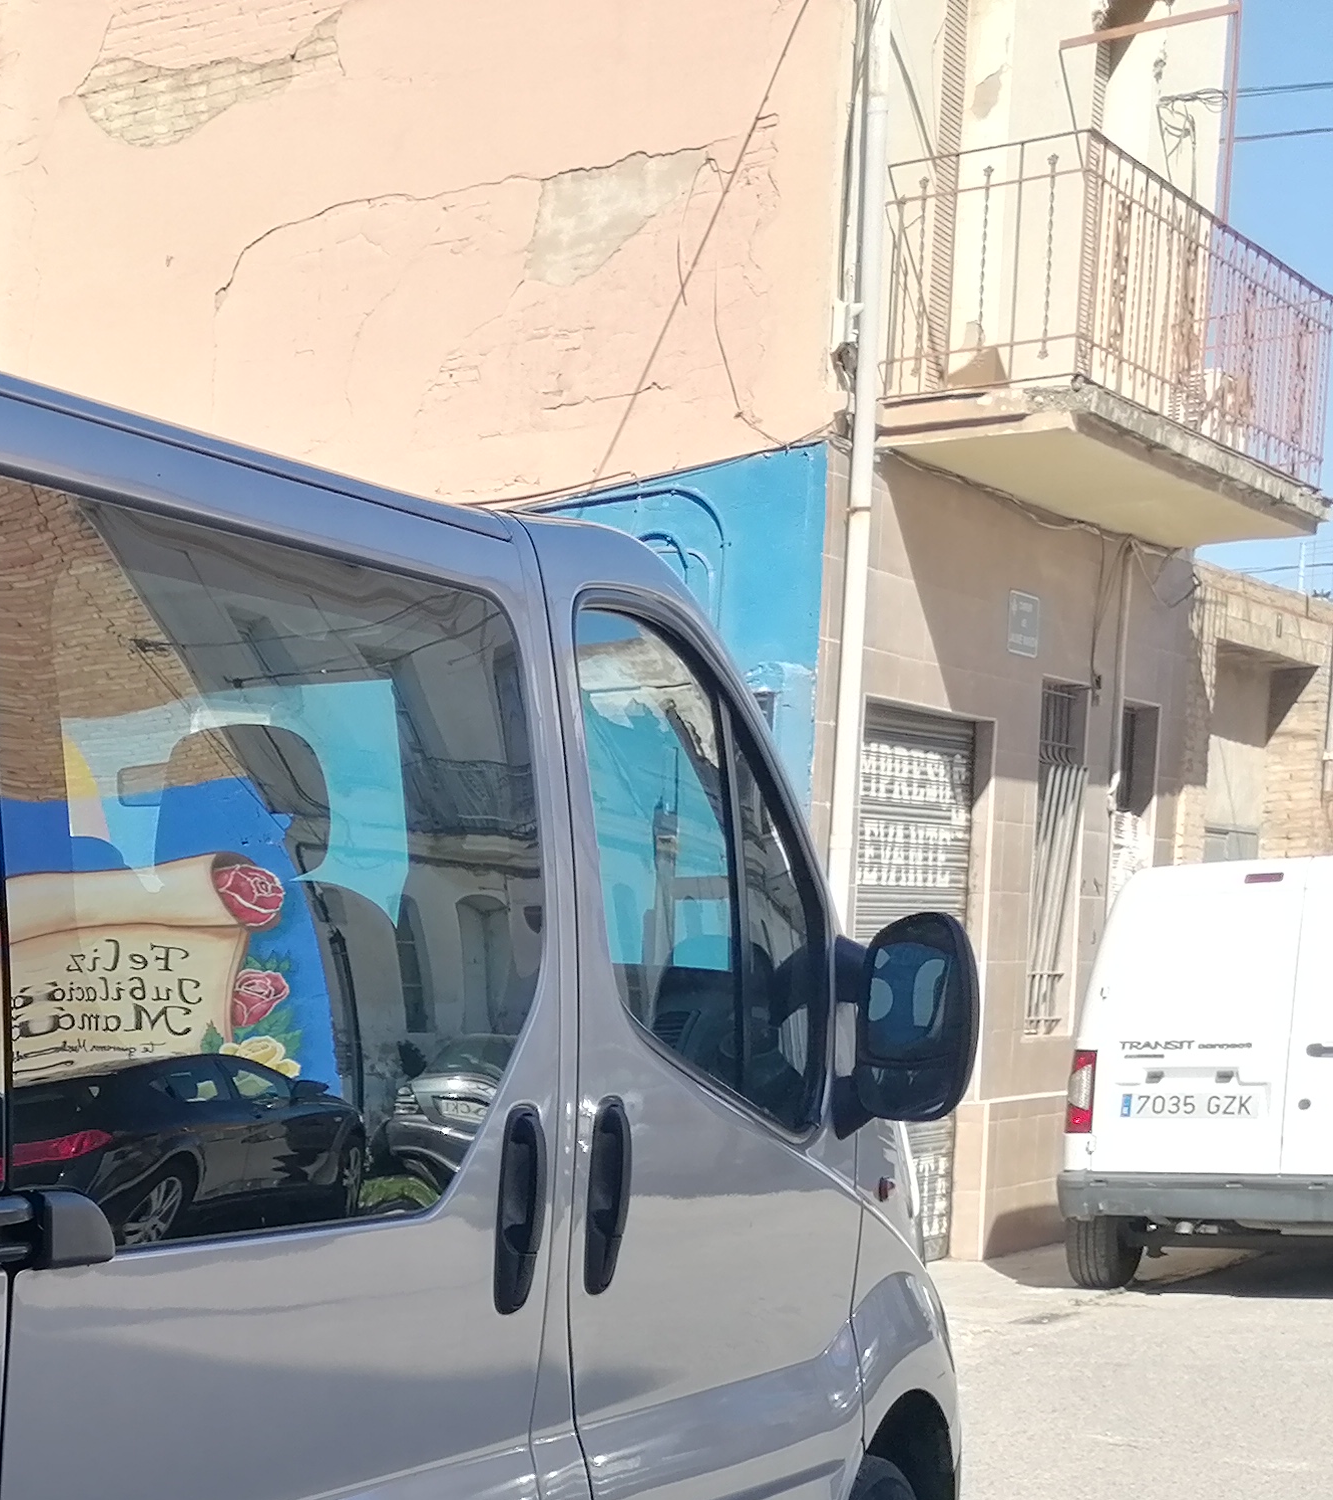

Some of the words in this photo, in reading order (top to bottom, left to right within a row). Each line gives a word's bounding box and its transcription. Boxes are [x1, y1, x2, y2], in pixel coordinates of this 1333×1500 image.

[1119, 1040, 1195, 1051] TRANSIT
[1136, 1095, 1196, 1115] 7035
[1207, 1095, 1252, 1116] GZK
